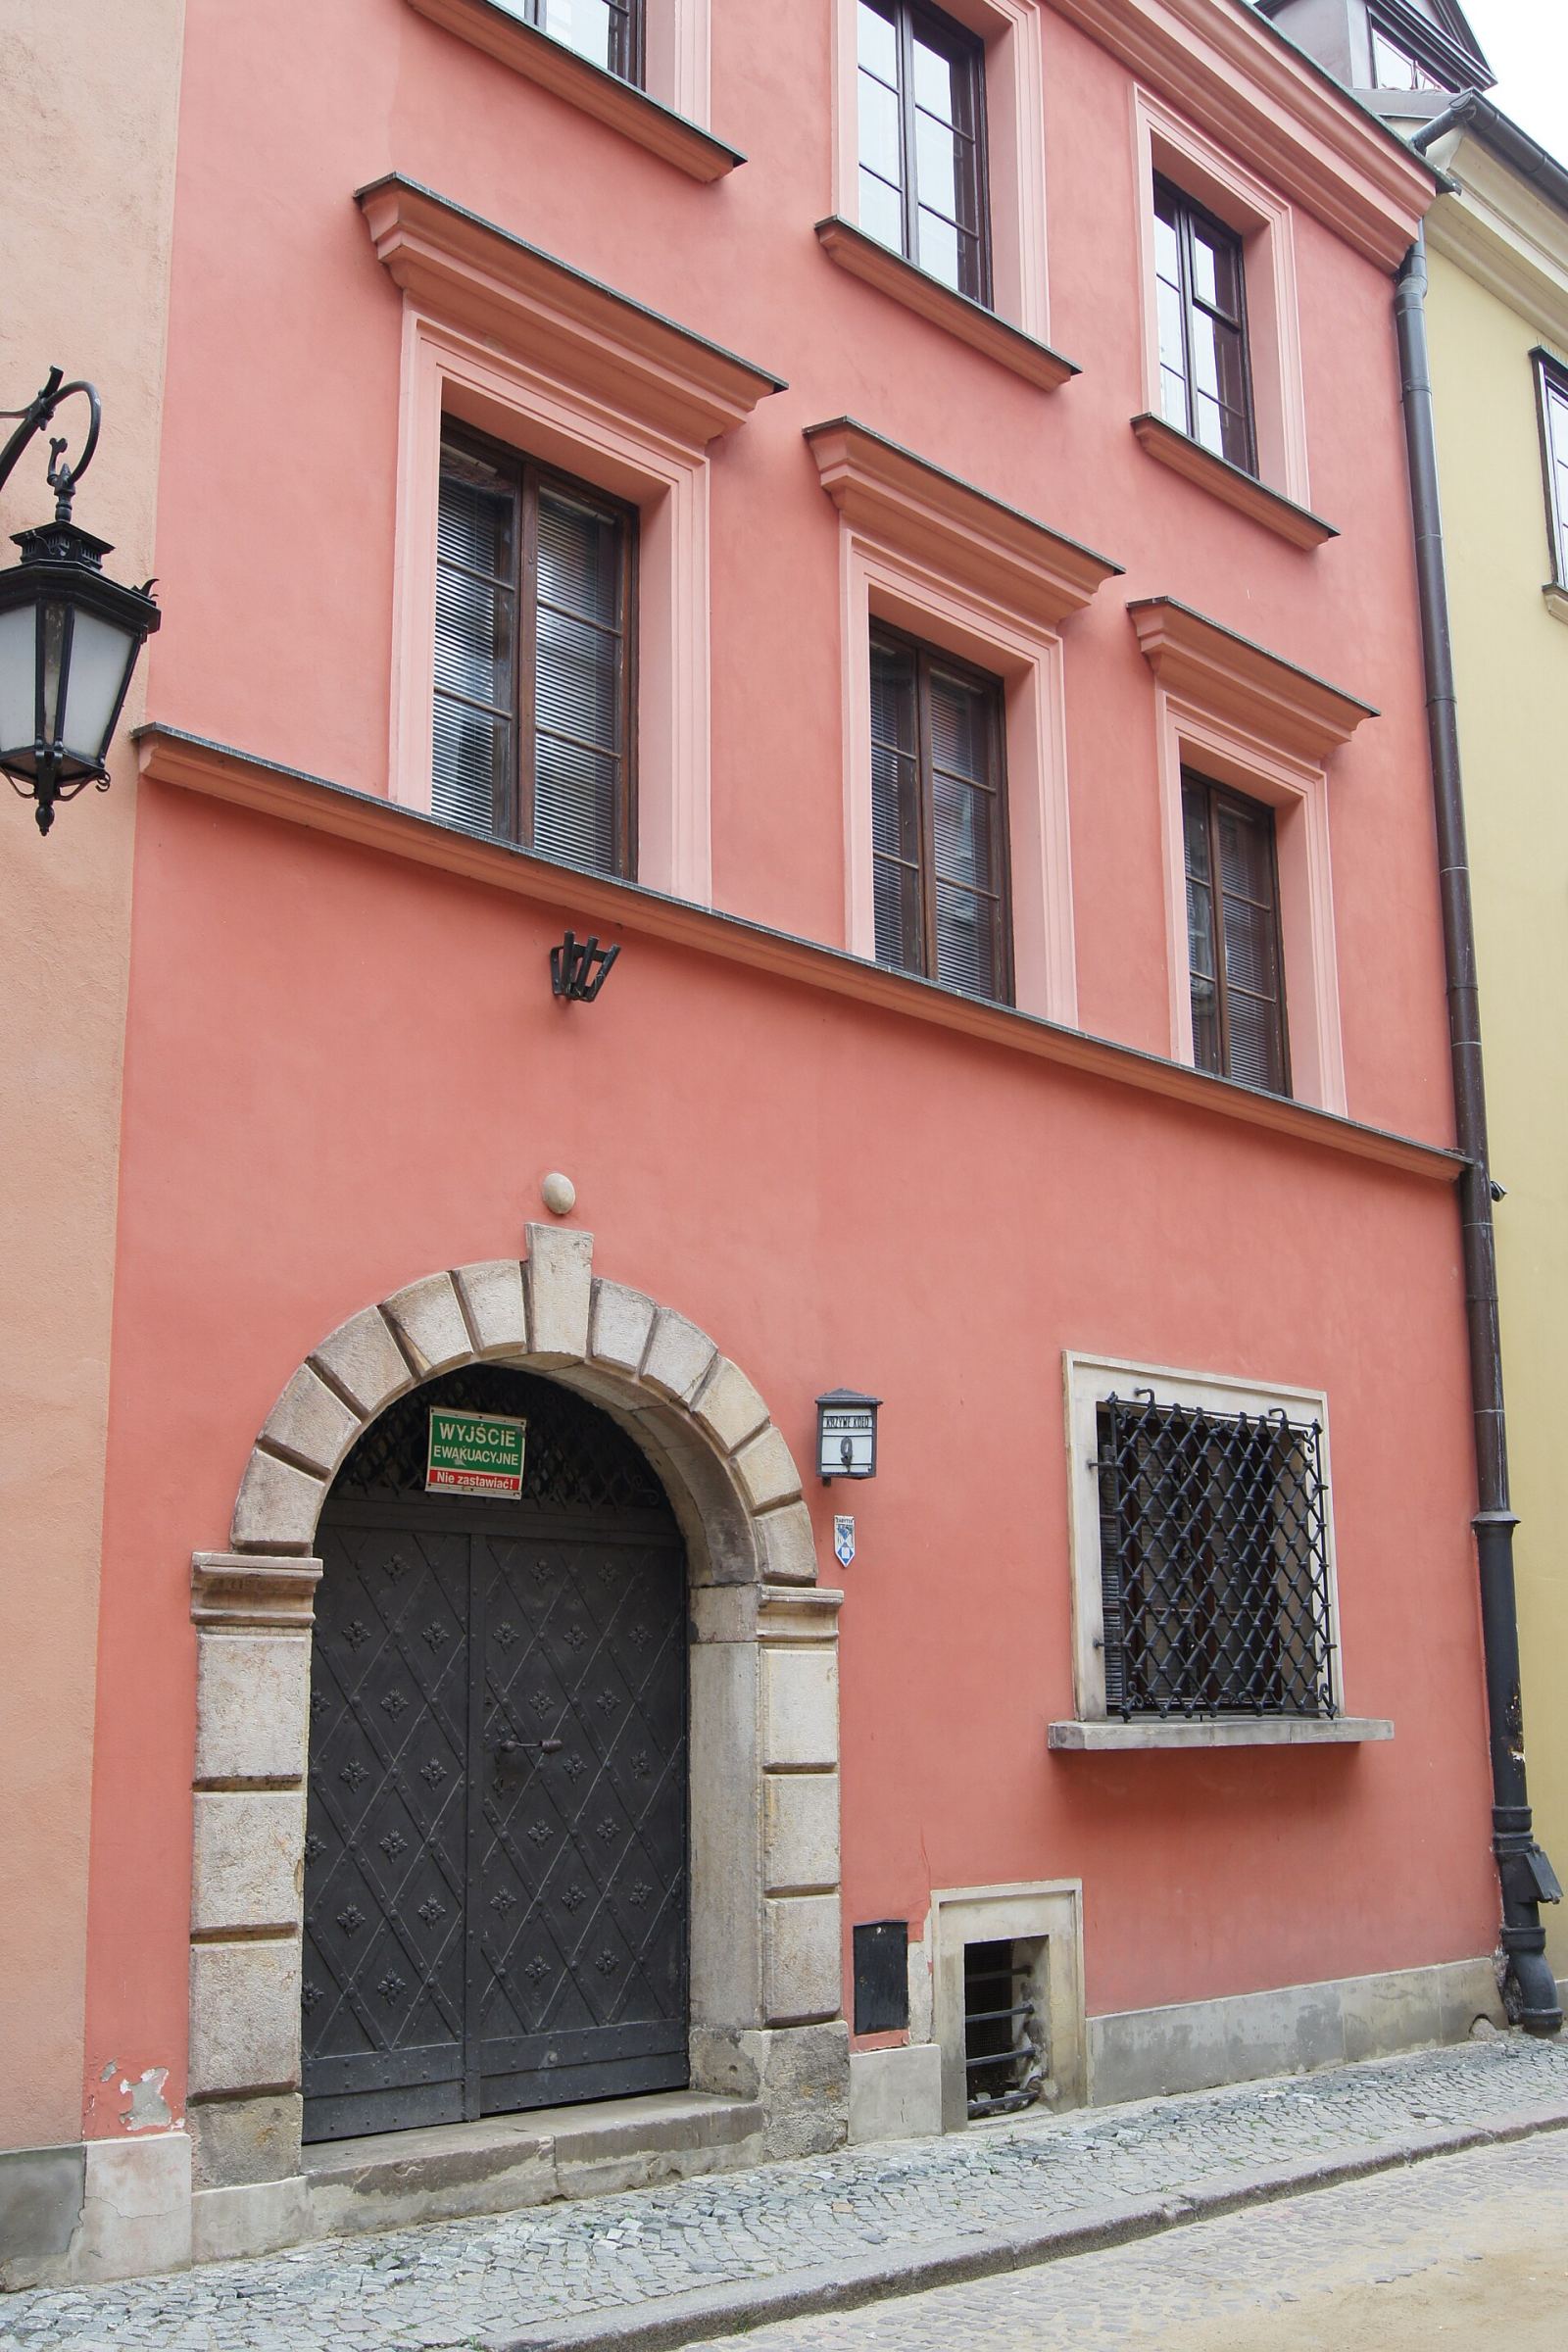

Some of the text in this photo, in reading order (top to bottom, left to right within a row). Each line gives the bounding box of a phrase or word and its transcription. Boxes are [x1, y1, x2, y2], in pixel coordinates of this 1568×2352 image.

[433, 1445, 519, 1466] EWAKUACYJNE
[840, 1437, 853, 1465] 9
[437, 1471, 514, 1490] Nie zastawiać!
